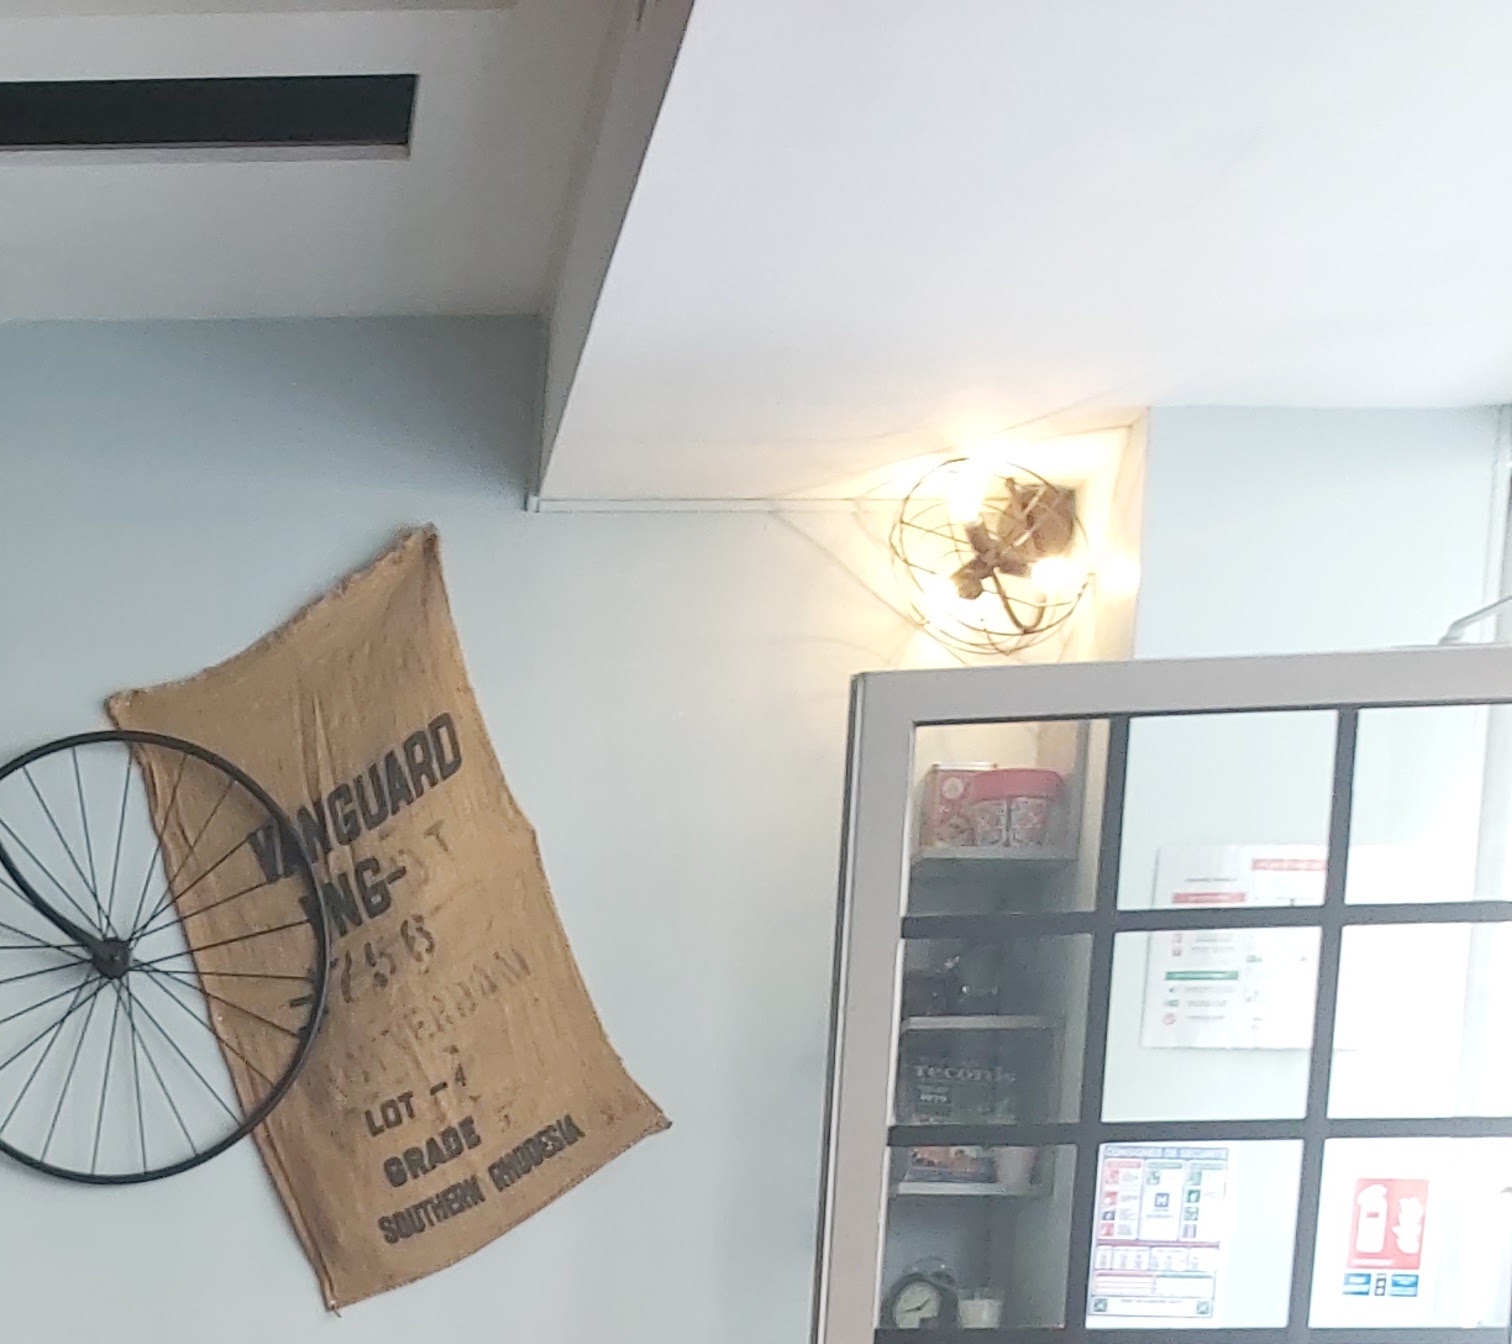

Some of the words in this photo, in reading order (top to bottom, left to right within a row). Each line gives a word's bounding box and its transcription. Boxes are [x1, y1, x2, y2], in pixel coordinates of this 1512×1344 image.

[364, 1090, 416, 1138] LOT
[378, 1174, 486, 1244] SOUTHERN
[488, 1114, 587, 1193] RHODESIA
